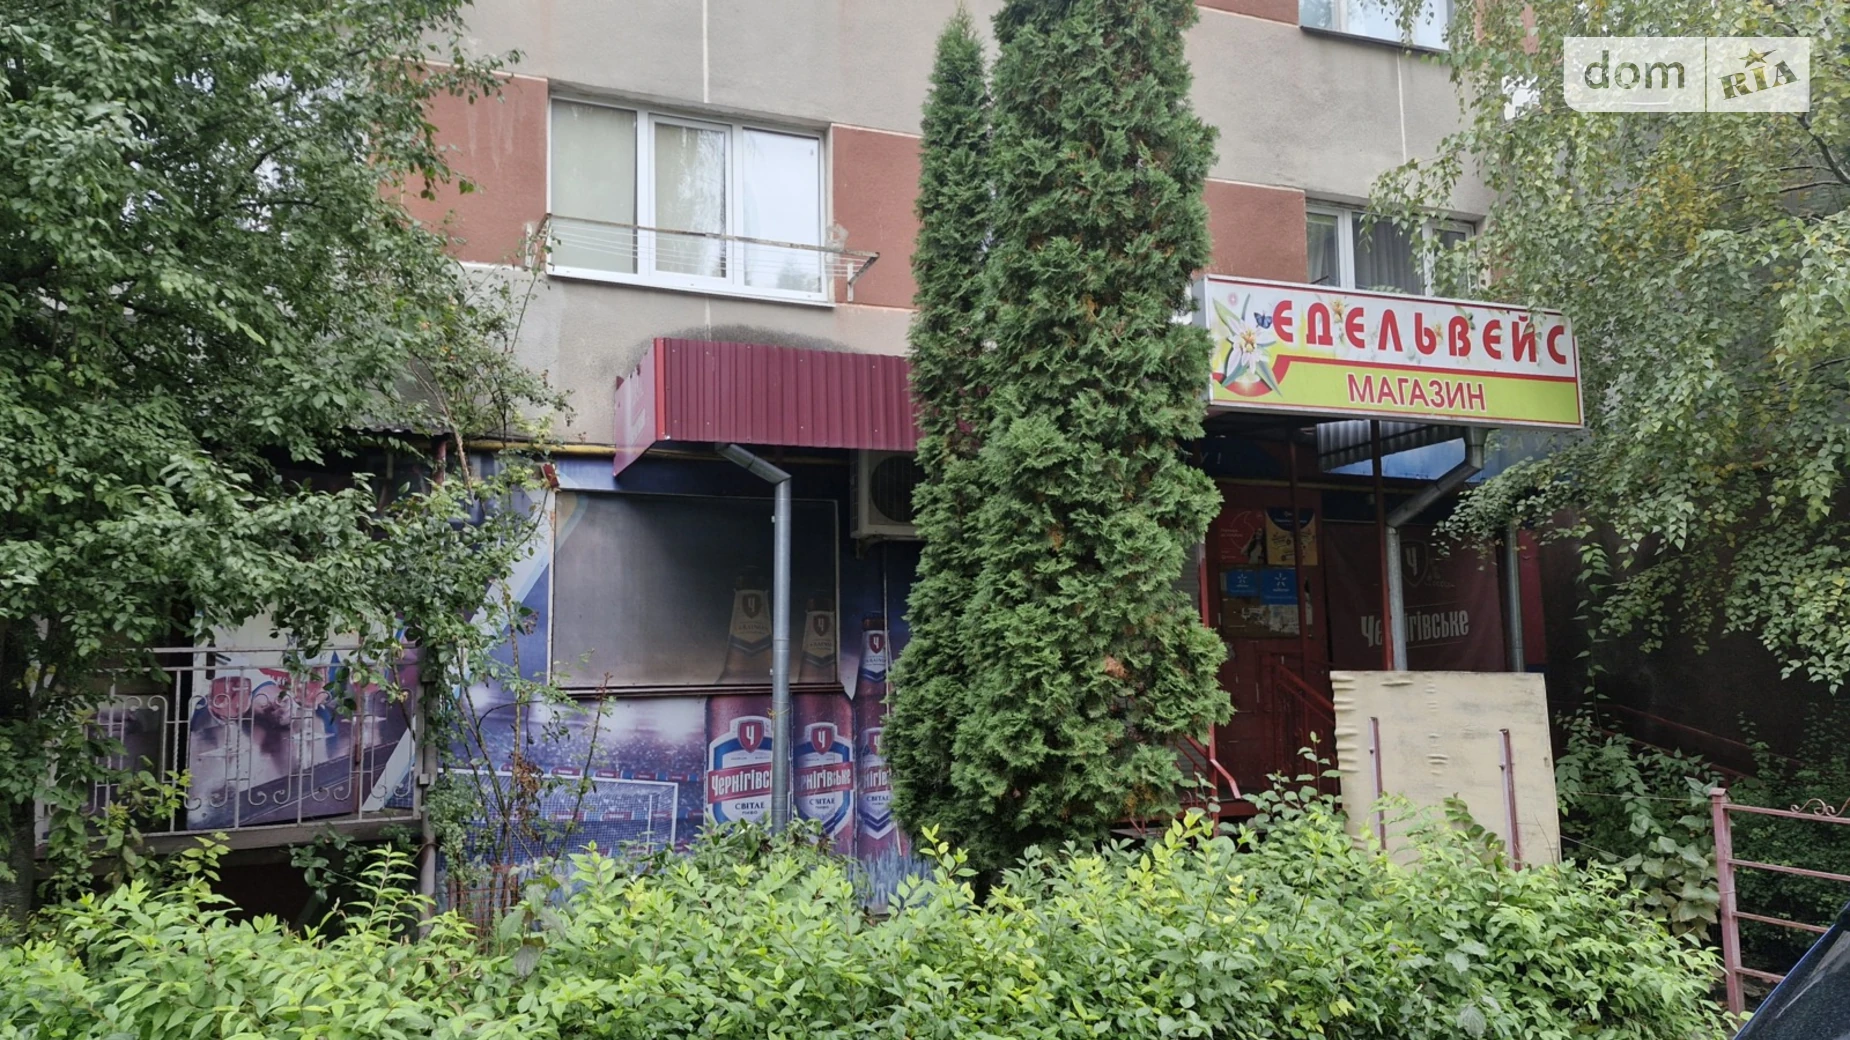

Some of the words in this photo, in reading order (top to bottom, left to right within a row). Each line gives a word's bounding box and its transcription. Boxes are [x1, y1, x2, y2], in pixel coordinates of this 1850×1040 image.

[1347, 373, 1487, 412] МАГАЗИН
[1360, 609, 1469, 648] Чеігівське
[711, 769, 773, 798] Чернігівс
